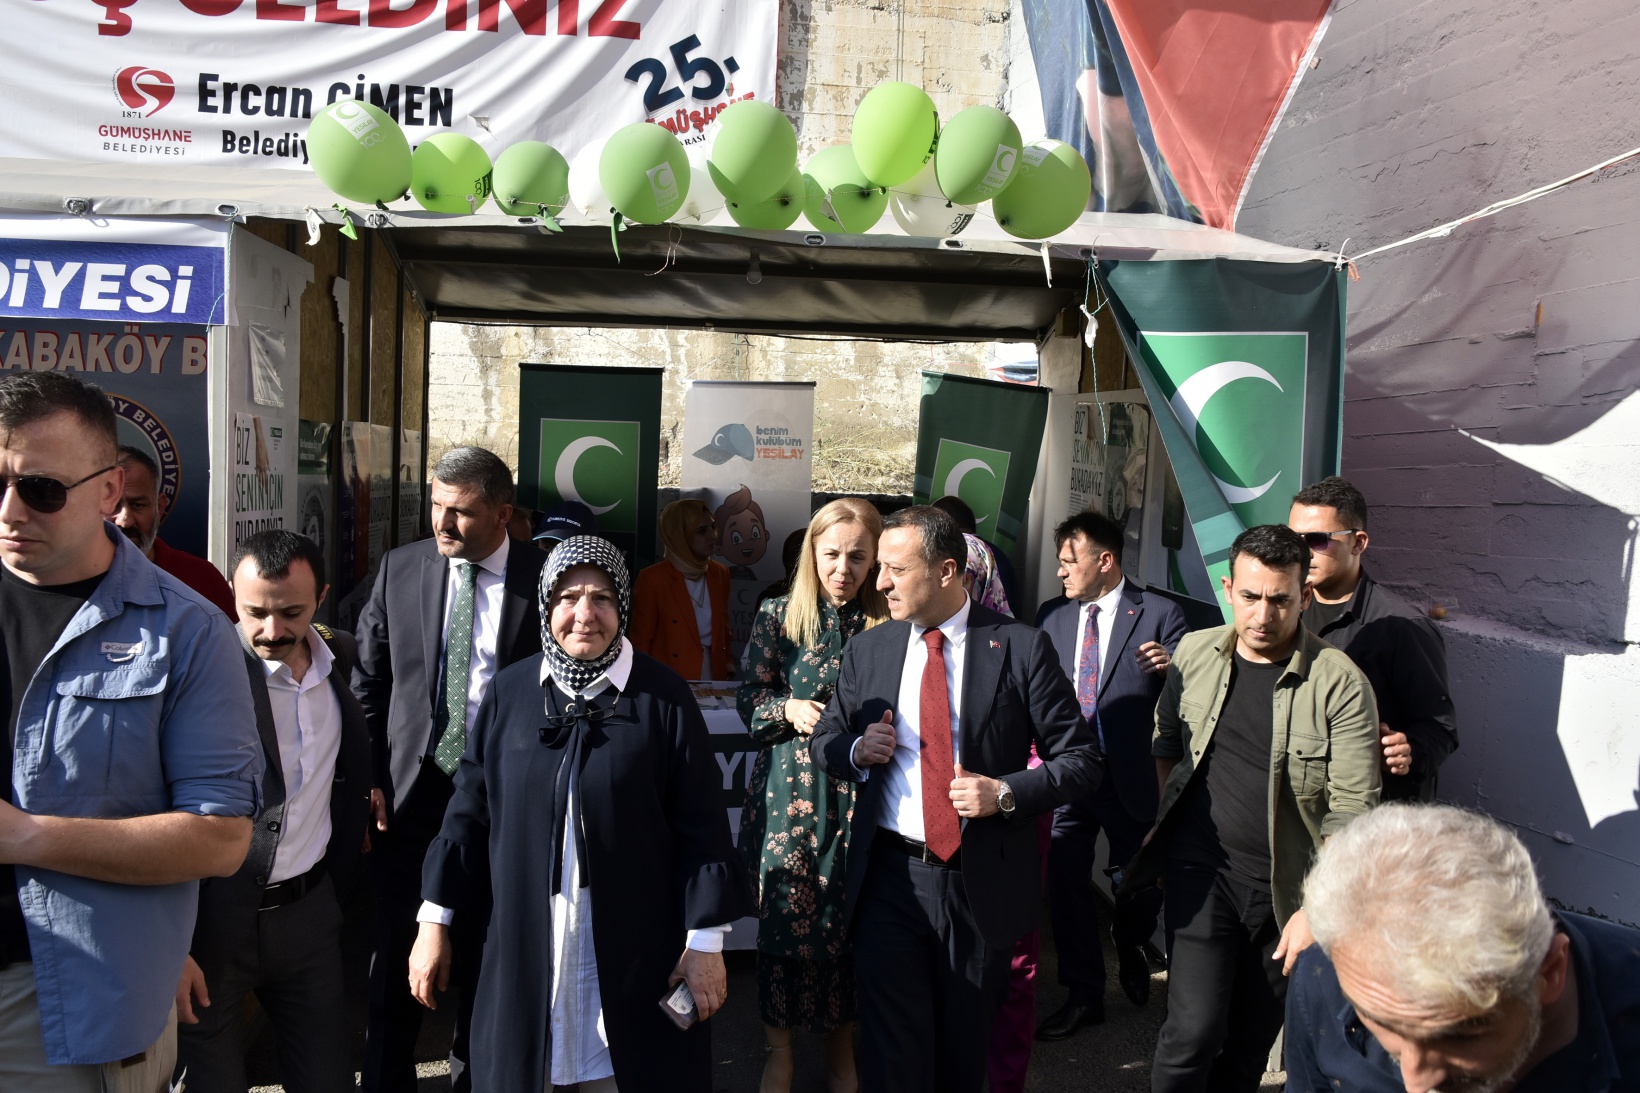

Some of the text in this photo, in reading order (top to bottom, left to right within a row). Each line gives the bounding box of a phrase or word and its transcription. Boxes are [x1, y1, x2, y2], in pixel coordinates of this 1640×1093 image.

[198, 72, 313, 120] Ercan
[121, 110, 142, 119] 1871
[98, 124, 192, 143] GÜMÜŞHANE
[0, 322, 174, 375] ABAKÖY
[755, 425, 789, 436] benim
[755, 435, 802, 447] kulübüm
[755, 446, 805, 461] YEŞİLAY
